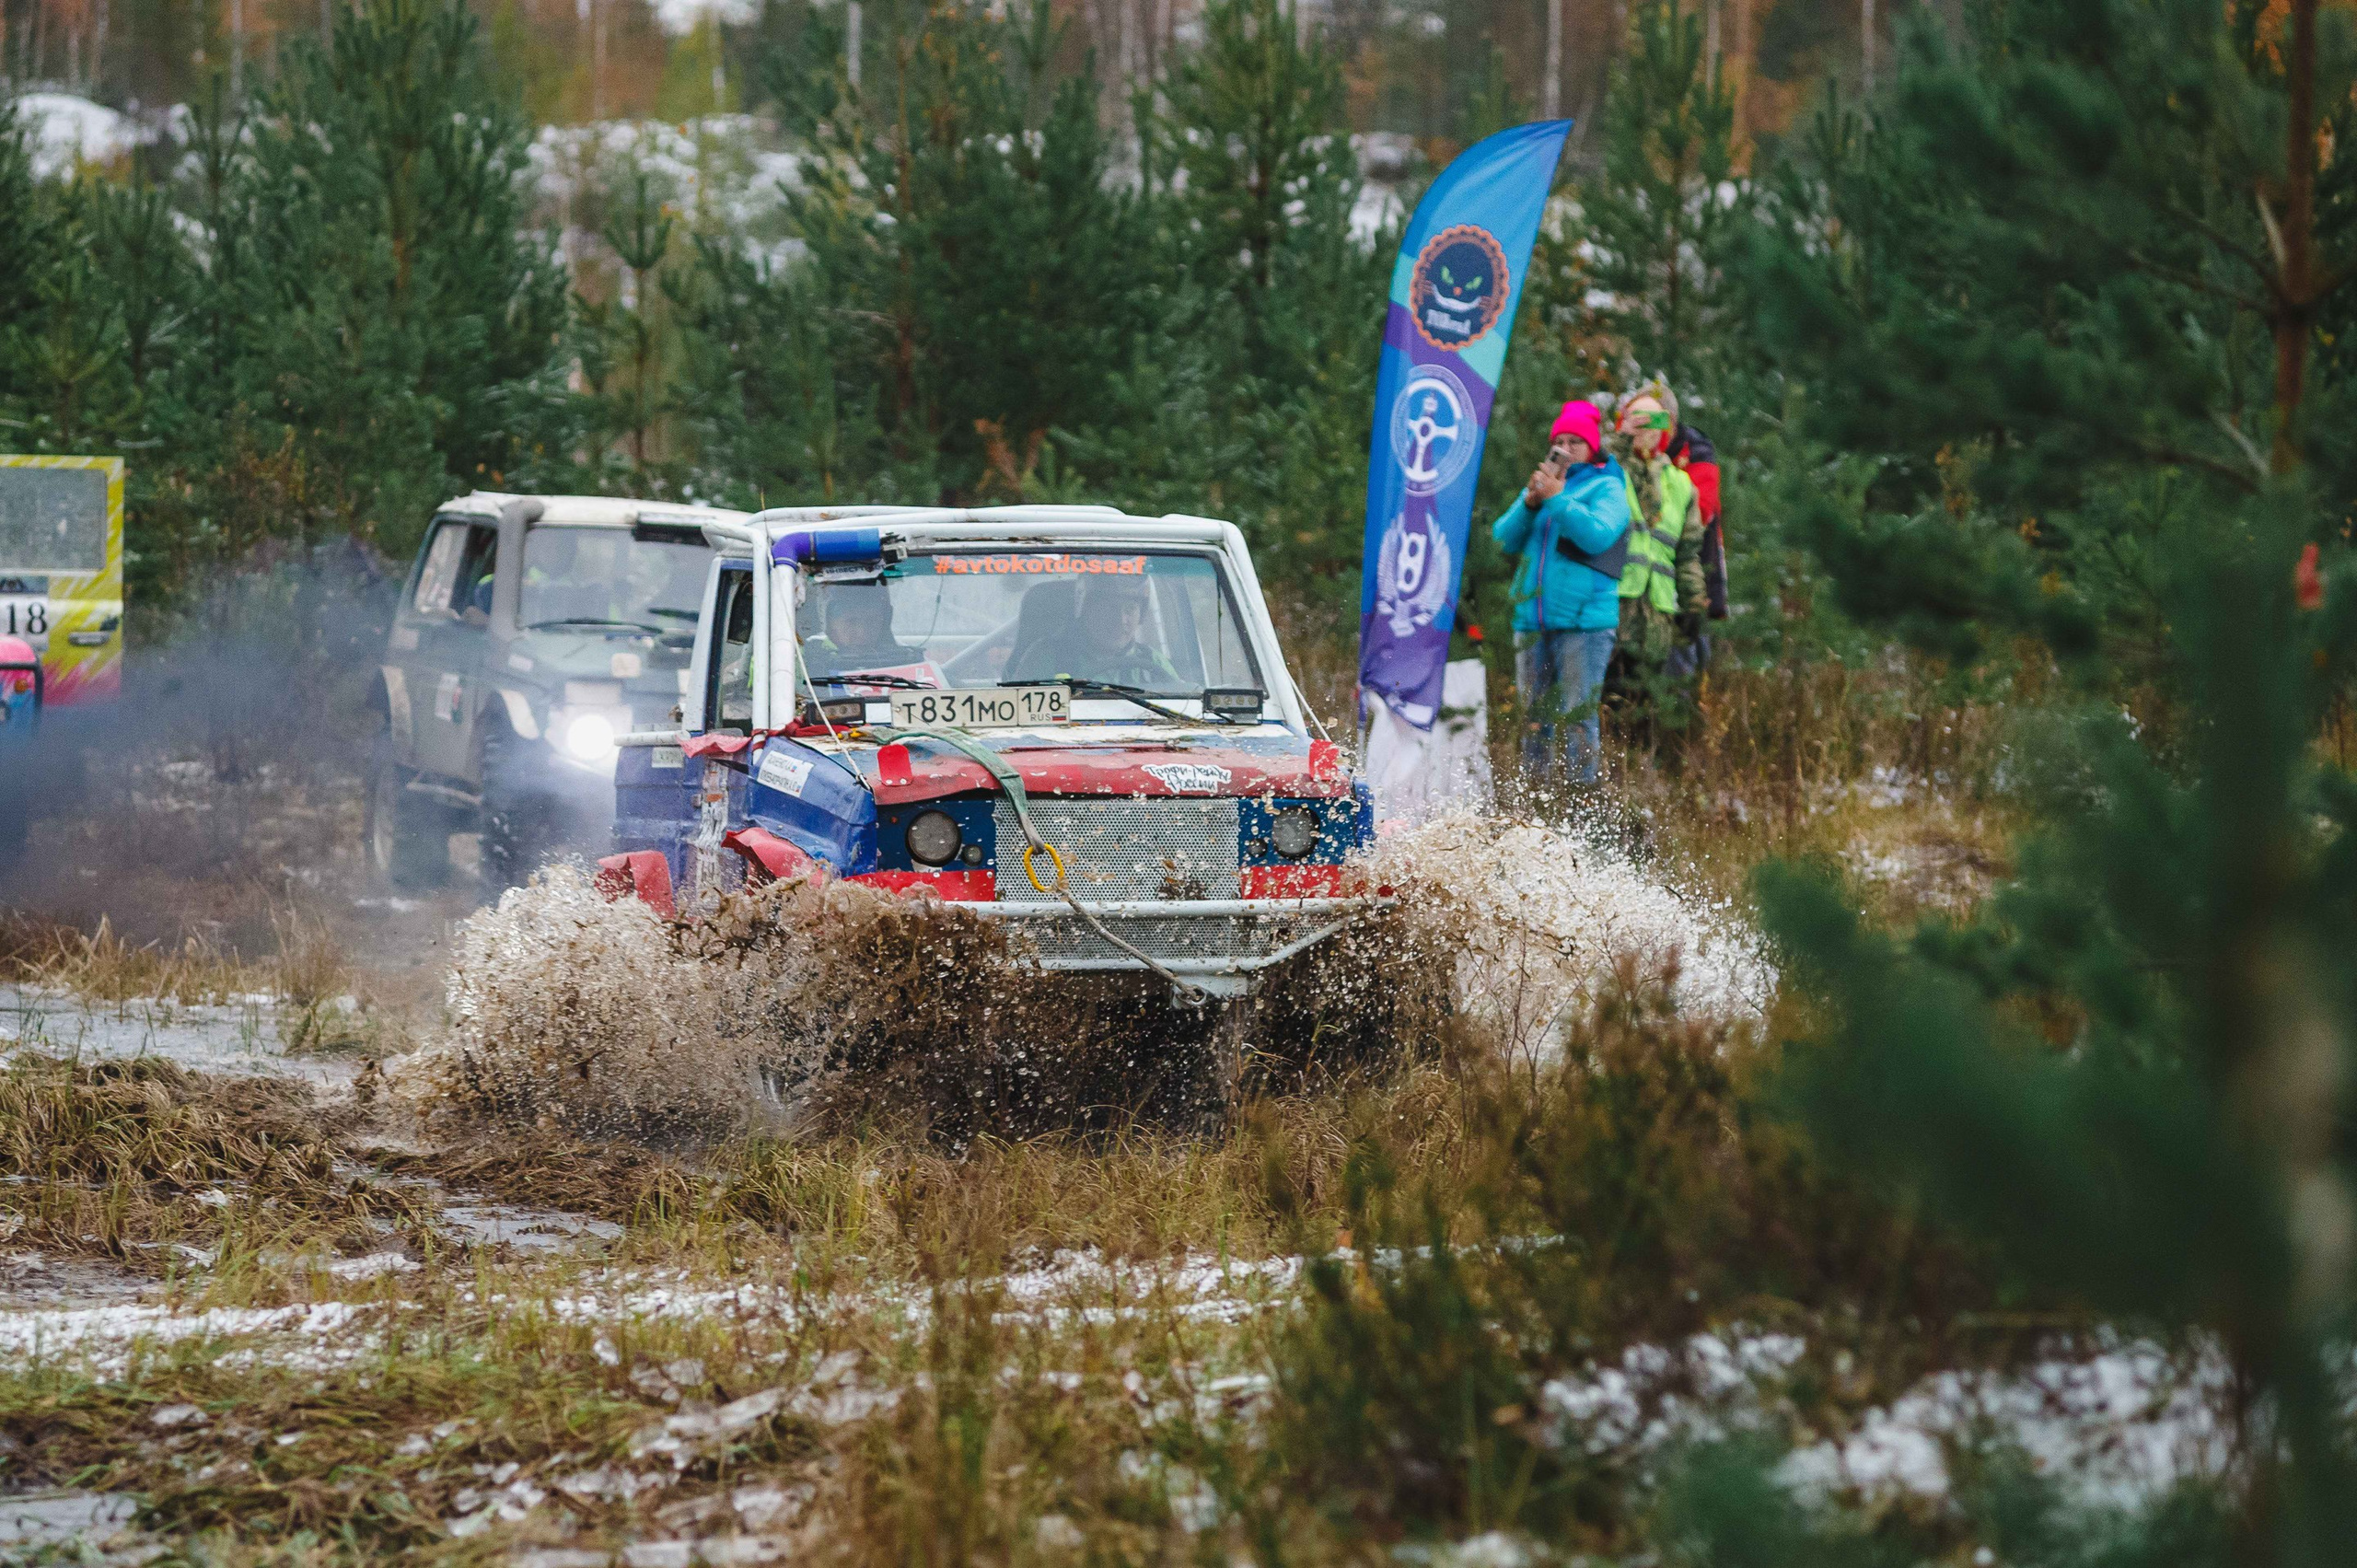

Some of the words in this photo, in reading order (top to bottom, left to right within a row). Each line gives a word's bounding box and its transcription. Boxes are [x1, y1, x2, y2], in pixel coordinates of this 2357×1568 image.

[935, 553, 1147, 575] #avtokotdosaaf
[901, 695, 1016, 725] Т831МО
[1021, 691, 1061, 713] 178
[1030, 714, 1051, 722] RUS
